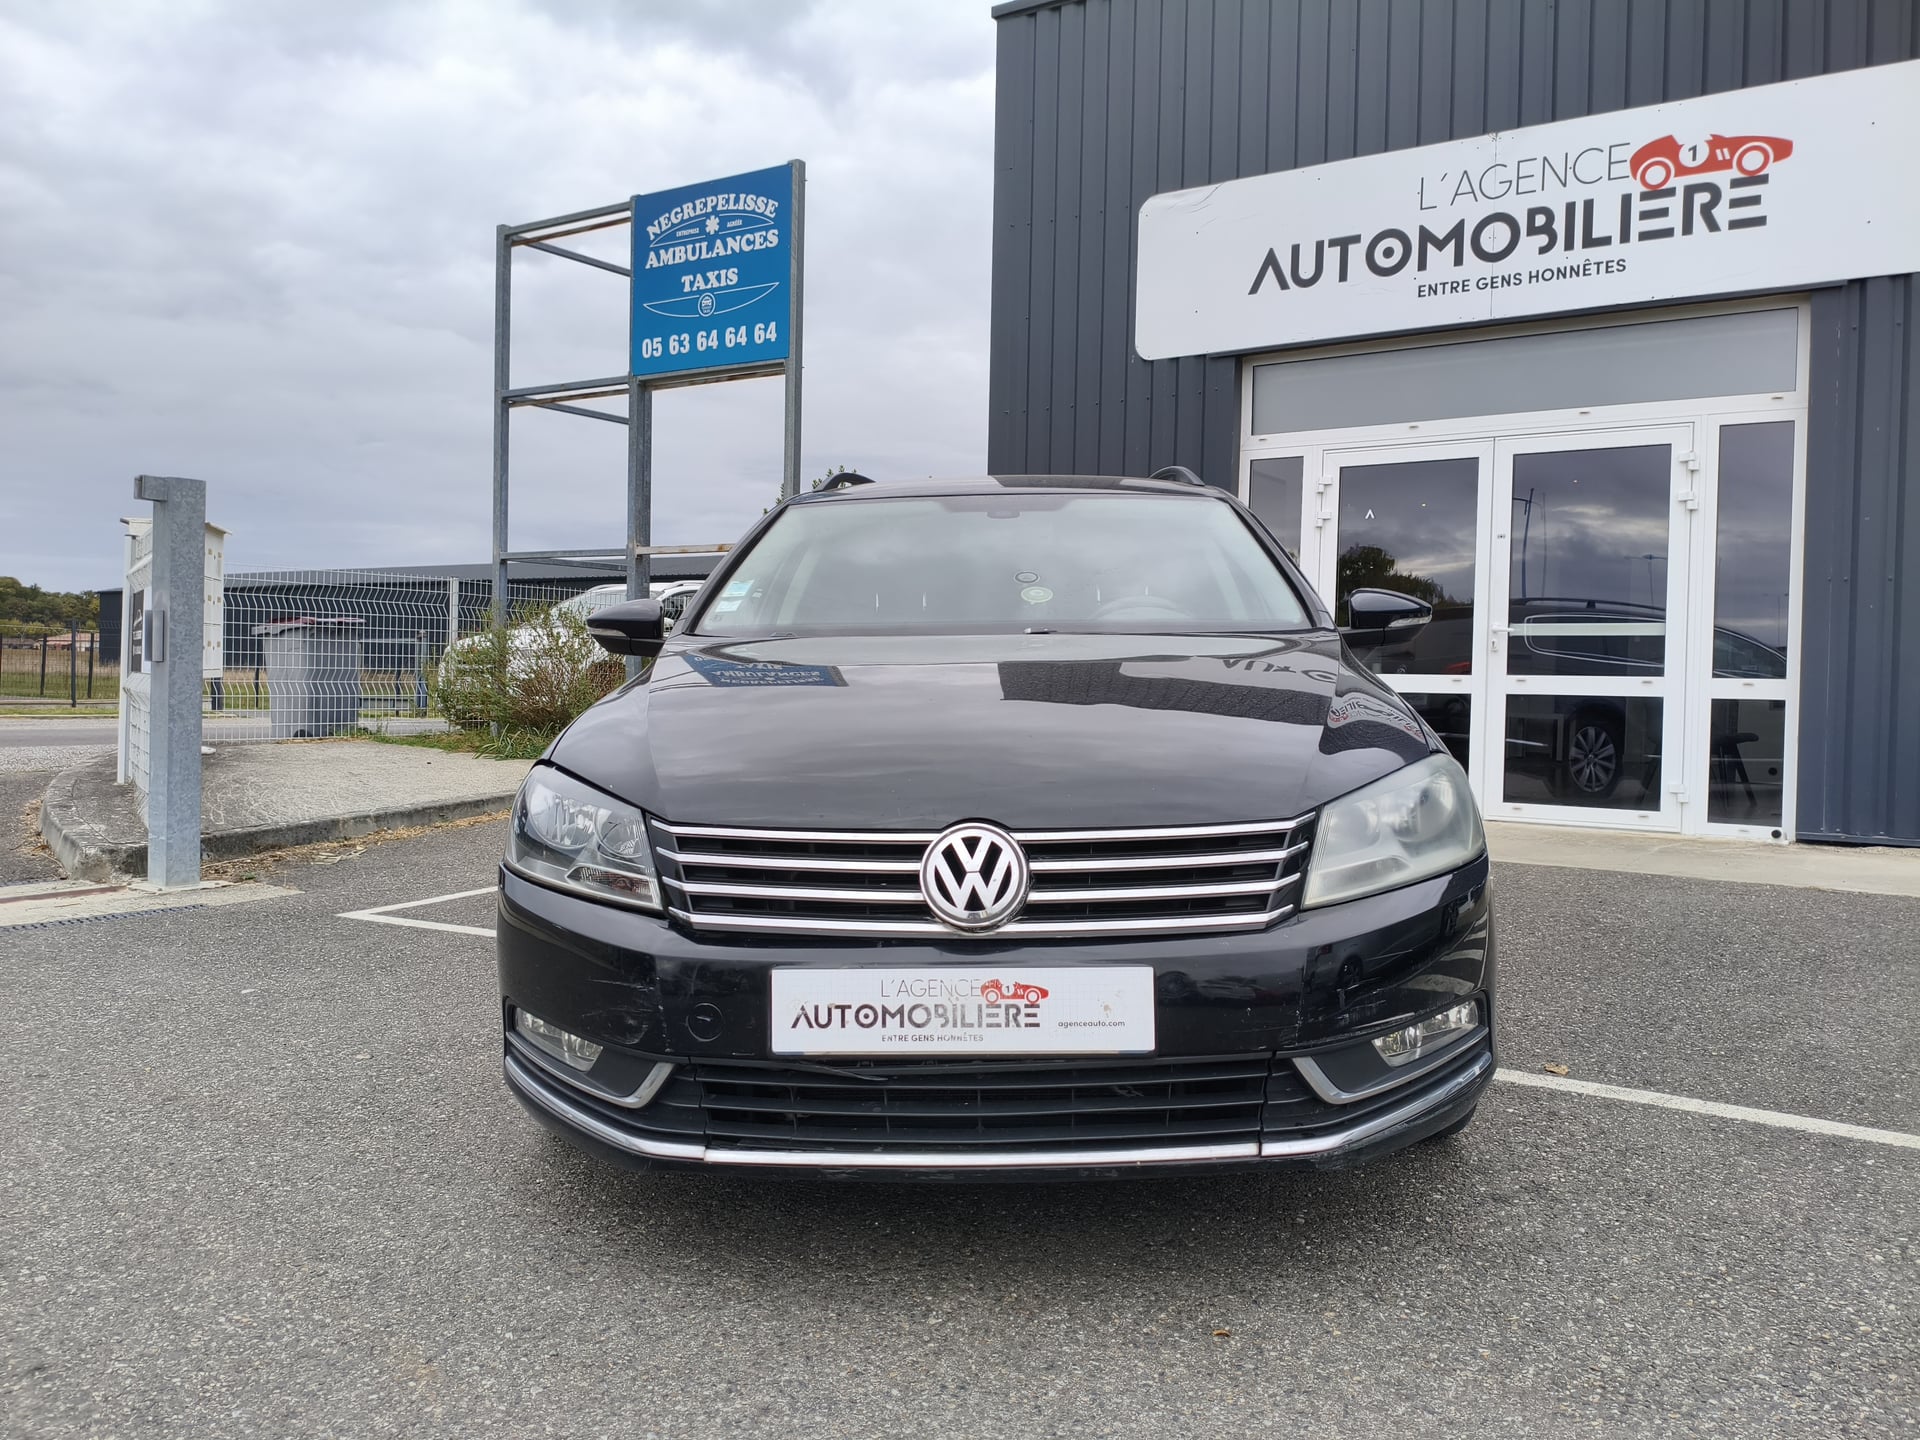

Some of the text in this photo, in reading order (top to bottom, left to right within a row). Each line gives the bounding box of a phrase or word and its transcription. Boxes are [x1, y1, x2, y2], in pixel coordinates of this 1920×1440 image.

[1687, 143, 1698, 162] 1
[1419, 142, 1631, 211] L'AGENCE
[646, 193, 779, 240] NEGREPELISSE
[645, 229, 779, 269] AMBULANCES
[681, 267, 738, 292] TAXIS
[1417, 258, 1627, 298] ENTRE GENS HONNÊTES
[642, 321, 777, 358] 05 63 64 64 64
[927, 829, 1019, 919] VW
[881, 1034, 909, 1042] ENTRE
[911, 1034, 935, 1042] GENS
[1057, 1020, 1126, 1028] agenceauto.com
